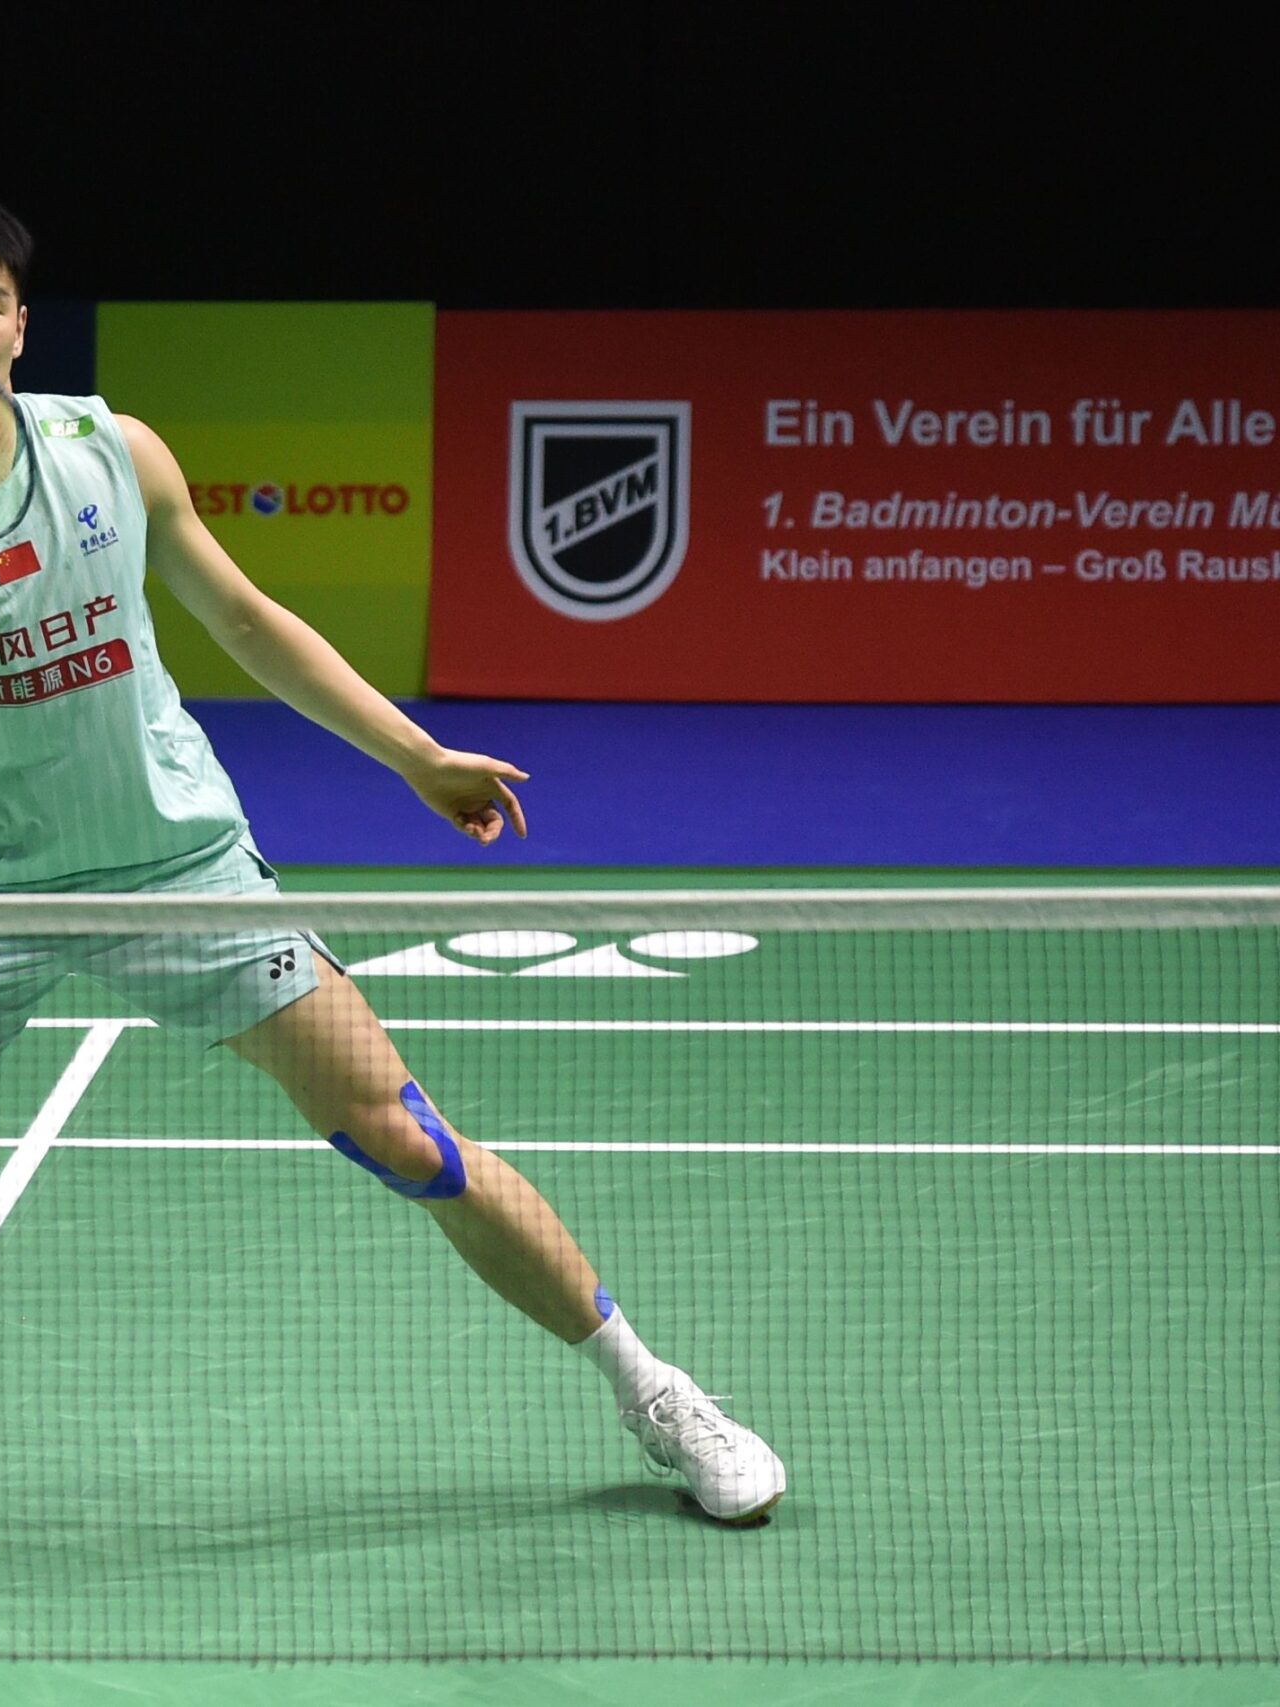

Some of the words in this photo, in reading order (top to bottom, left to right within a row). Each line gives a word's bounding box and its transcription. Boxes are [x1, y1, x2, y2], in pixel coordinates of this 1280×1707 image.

[764, 399, 855, 446] Ein
[873, 399, 1052, 446] Verein
[1071, 398, 1152, 446] für
[1166, 399, 1276, 446] Alle
[287, 483, 410, 516] LOTTO
[544, 461, 658, 546] 1.BVM
[763, 492, 796, 529] 1.
[810, 491, 1214, 529] Badminton-Verein
[761, 549, 852, 581] Klein
[863, 549, 1032, 589] anfangen
[1075, 549, 1166, 581] Groß
